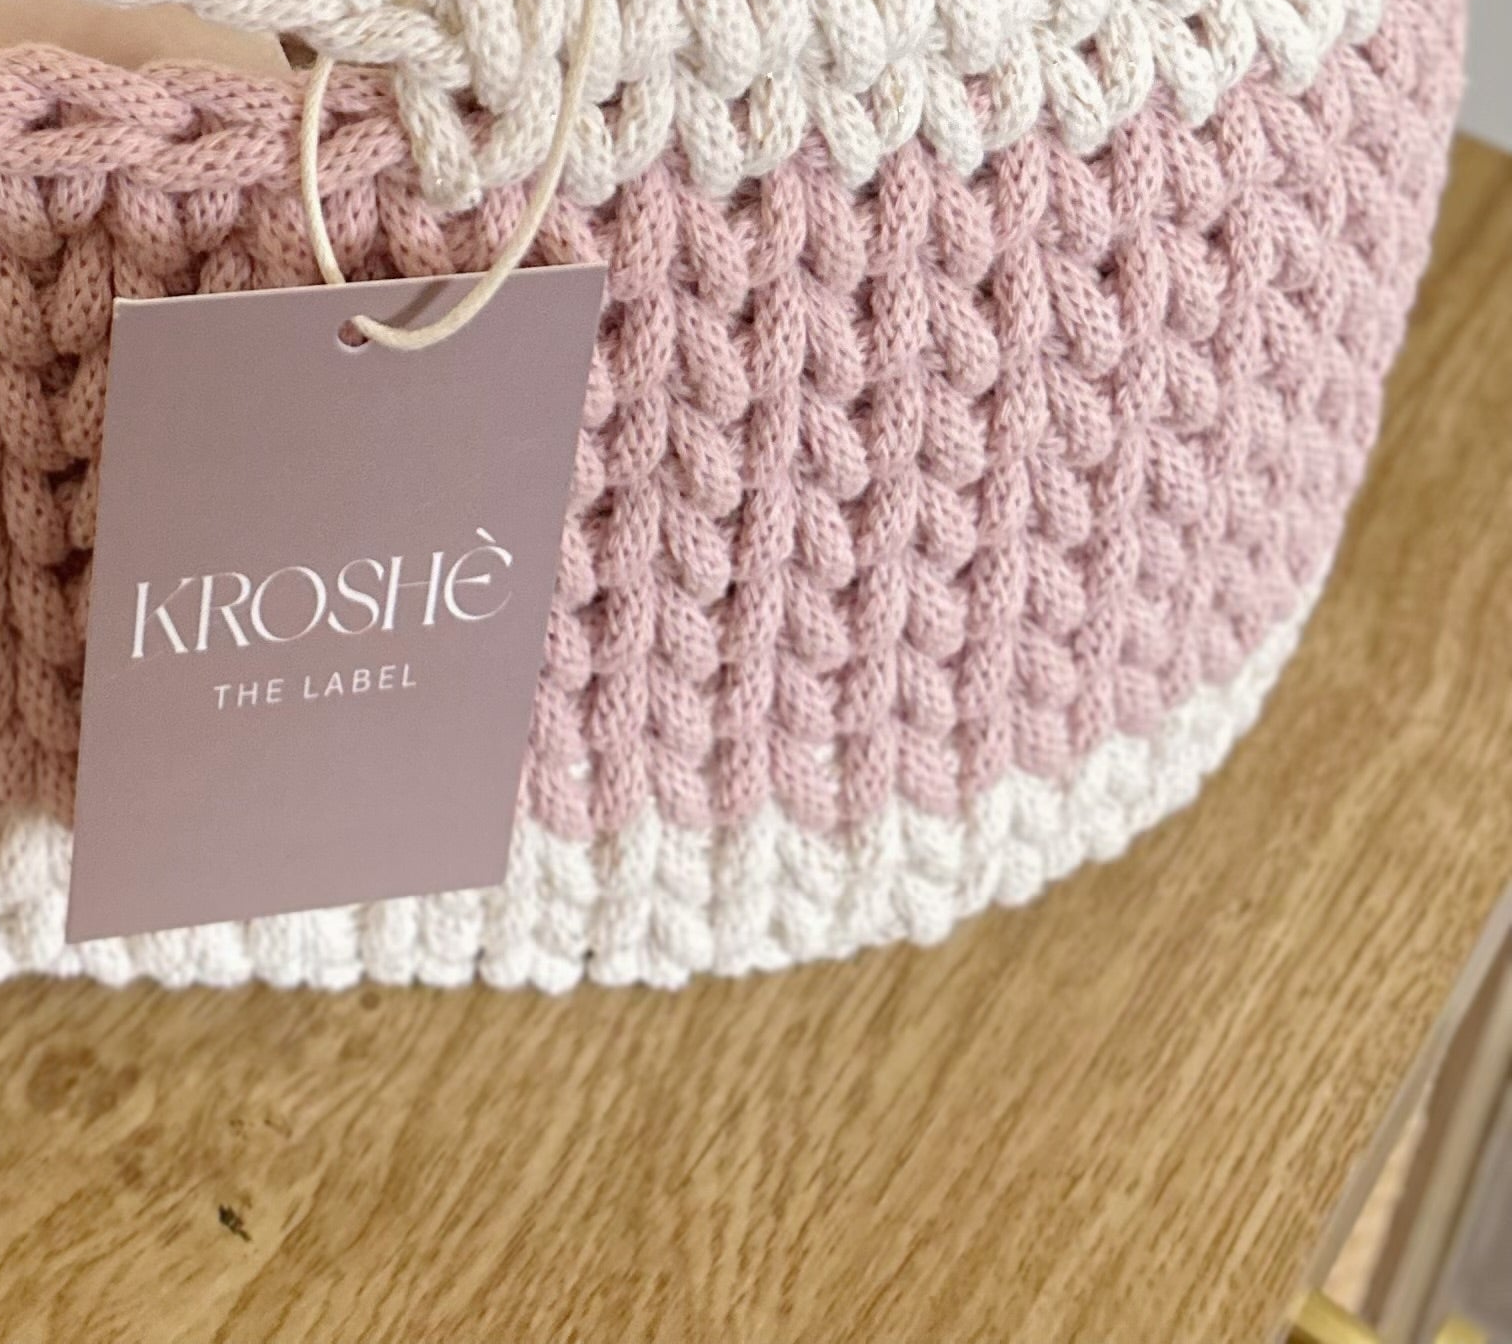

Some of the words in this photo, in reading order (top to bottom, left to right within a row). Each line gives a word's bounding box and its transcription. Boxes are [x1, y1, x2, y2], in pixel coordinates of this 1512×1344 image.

[131, 527, 513, 659] KROSHÈ
[213, 677, 284, 710] THE
[303, 662, 417, 700] LABEL
